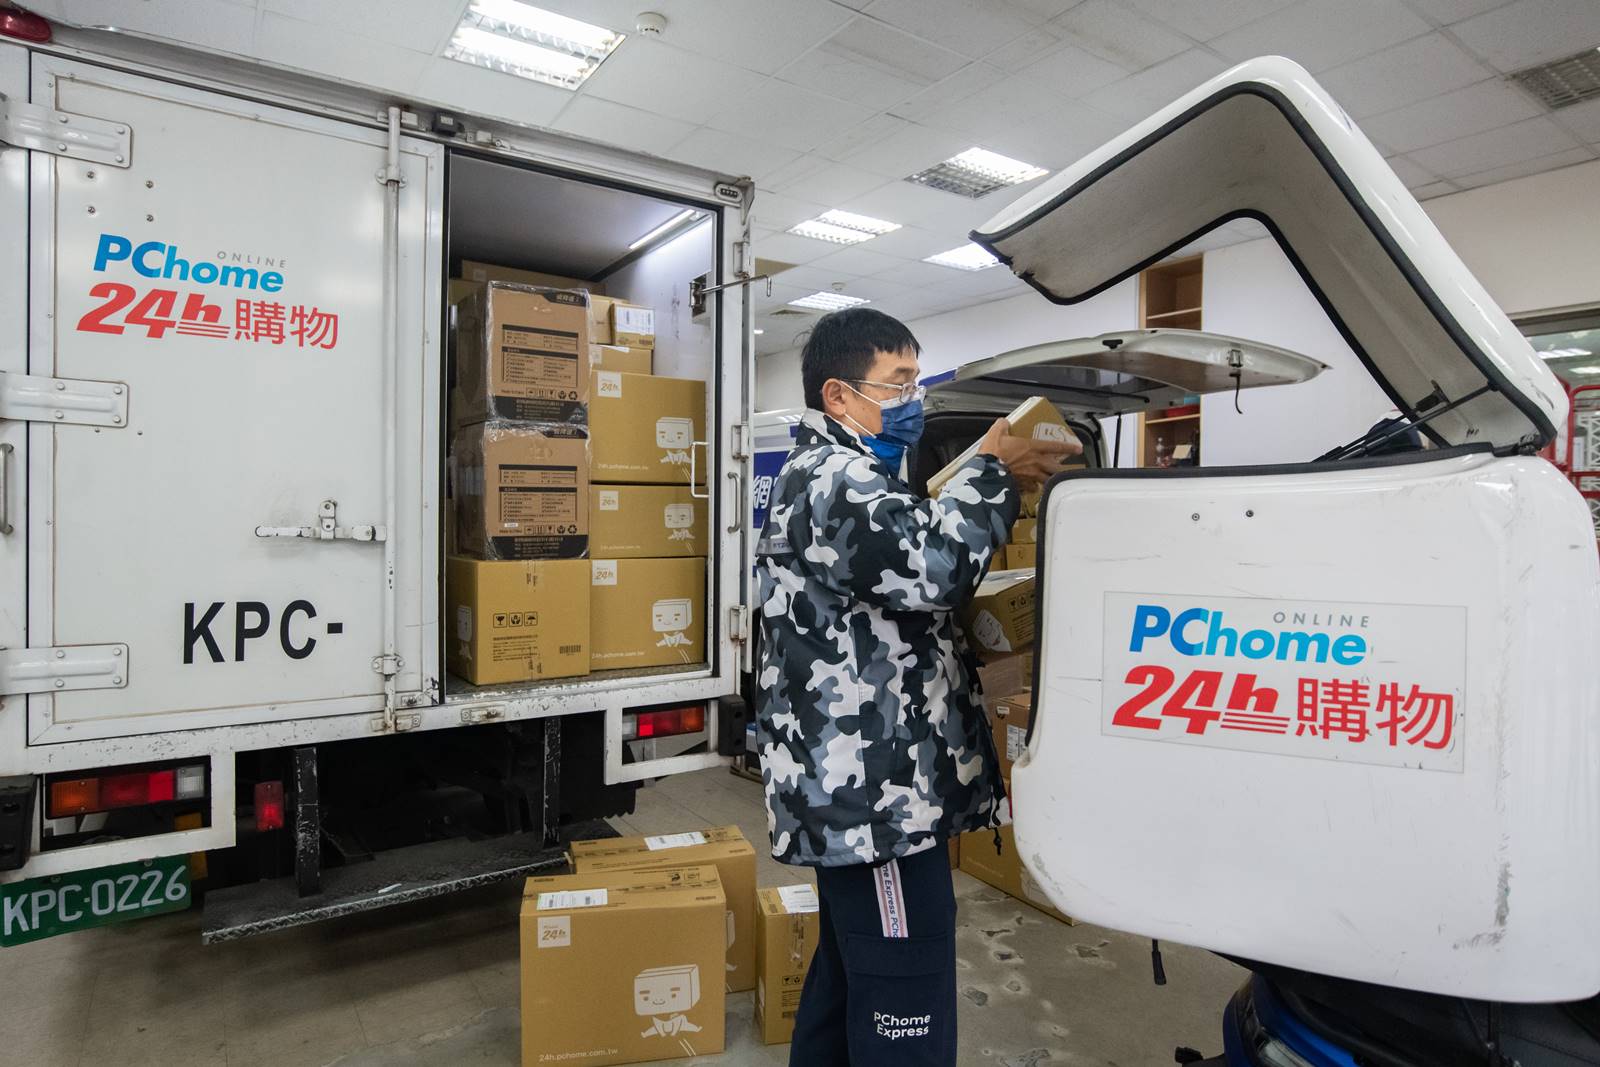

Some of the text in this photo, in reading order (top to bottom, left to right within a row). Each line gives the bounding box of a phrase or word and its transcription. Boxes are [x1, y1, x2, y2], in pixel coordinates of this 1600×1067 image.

[93, 234, 284, 293] PChome
[217, 251, 287, 268] ONLINE
[76, 282, 339, 350] 24h購物
[753, 475, 779, 509] 網
[183, 600, 343, 664] KPC-
[1129, 604, 1367, 666] PChome
[1273, 611, 1370, 628] ONLINE
[1112, 665, 1454, 750] 24h購物
[3, 864, 187, 936] KPC-0226
[884, 880, 896, 915] Express
[874, 1011, 931, 1026] PChome
[876, 1023, 929, 1041] Express
